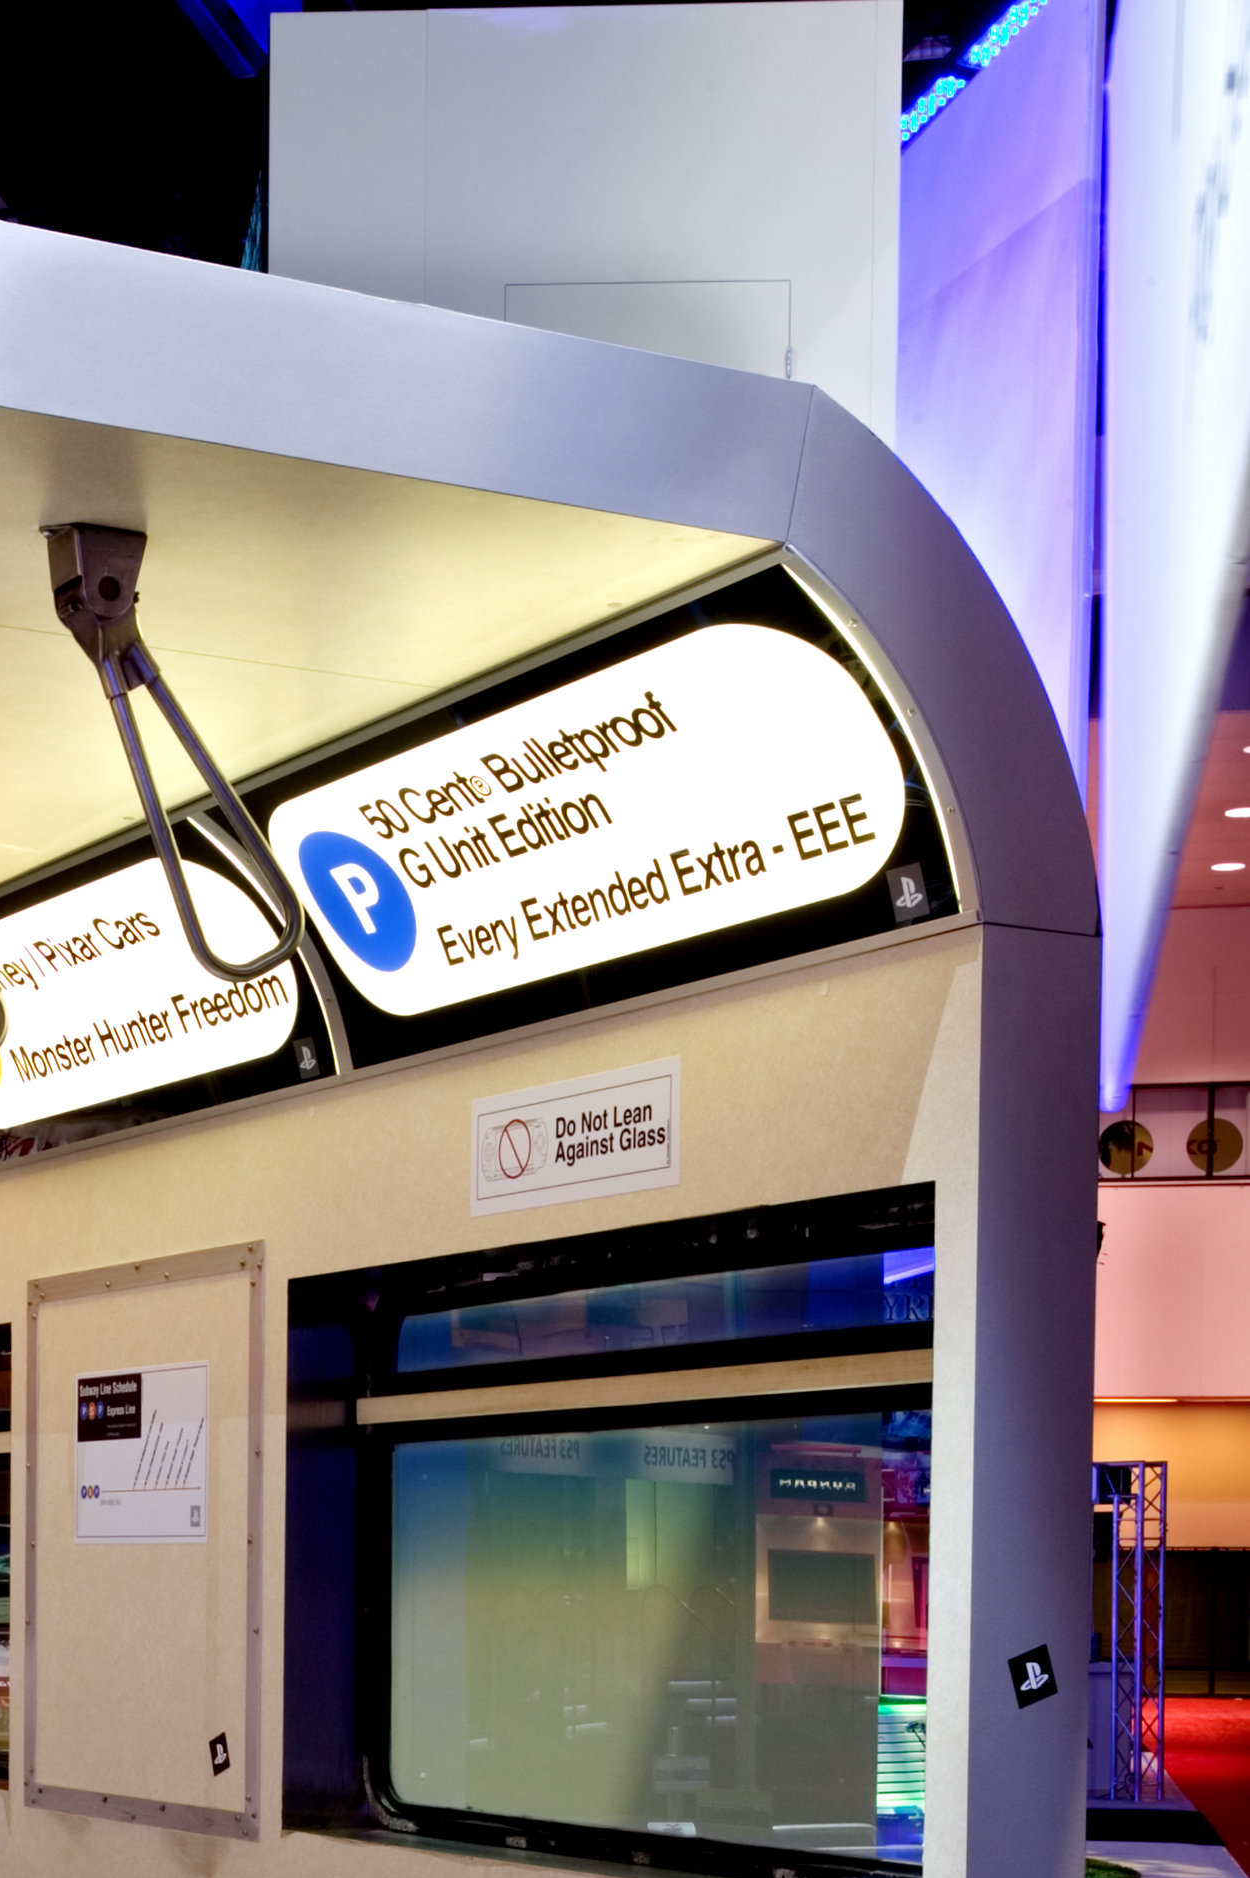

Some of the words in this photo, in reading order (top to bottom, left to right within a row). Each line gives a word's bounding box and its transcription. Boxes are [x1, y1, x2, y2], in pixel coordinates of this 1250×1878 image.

[358, 799, 410, 840] 50
[479, 691, 677, 794] Bulletproof
[399, 848, 437, 889] G
[424, 825, 501, 879] Unit
[487, 793, 613, 858] Edition
[329, 863, 379, 935] P
[436, 916, 519, 966] Every
[520, 858, 670, 942] Extended
[672, 840, 766, 896] Extra
[786, 794, 876, 861] EEE
[33, 932, 102, 972] Pixar
[92, 912, 161, 950] Cars
[9, 1035, 95, 1082] Monster
[93, 1010, 173, 1058] Hunter
[170, 974, 289, 1034] Freedom
[555, 1116, 576, 1138] Do
[581, 1109, 608, 1134] Not
[613, 1104, 653, 1127] Lean
[555, 1132, 614, 1167] Against
[620, 1125, 666, 1151] Glass
[100, 1383, 112, 1395] Line
